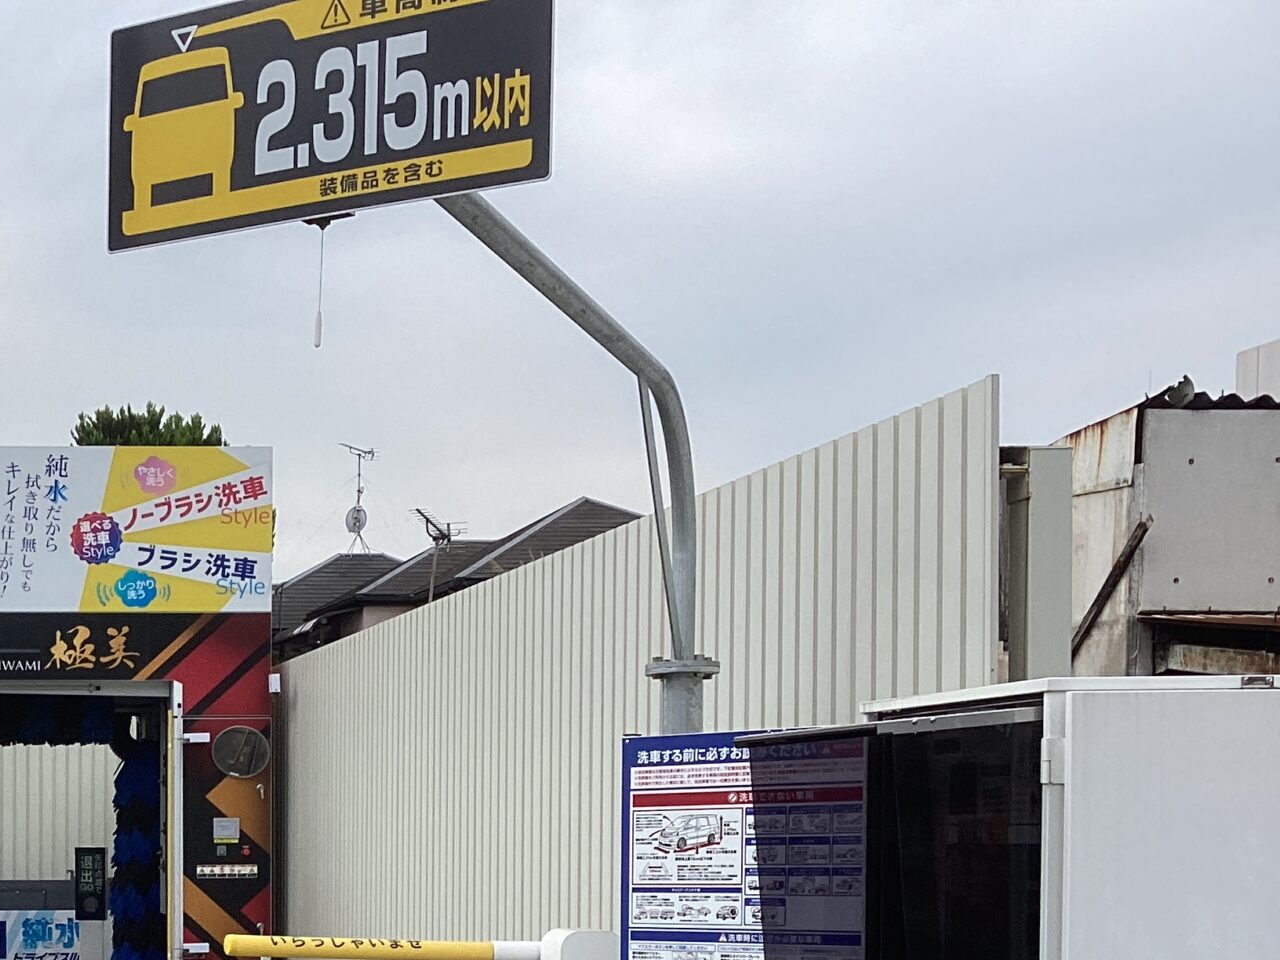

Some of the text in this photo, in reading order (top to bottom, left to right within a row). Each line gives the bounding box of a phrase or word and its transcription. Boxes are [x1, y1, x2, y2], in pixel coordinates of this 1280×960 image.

[320, 159, 443, 197] 装備品を含む
[137, 466, 175, 478] やさしく
[44, 454, 69, 552] 純水だから
[123, 476, 267, 531] ノーブラシ洗車
[80, 519, 112, 531] 選べる
[221, 508, 270, 529] Style
[20, 473, 41, 592] 拭き取り無しでも
[83, 532, 110, 545] 洗車
[83, 546, 115, 559] Style
[137, 545, 258, 581] ブラシ洗車
[118, 578, 155, 592] しっかり
[216, 578, 265, 598] Style
[43, 625, 141, 671] 極美
[22, 917, 79, 949] 純水
